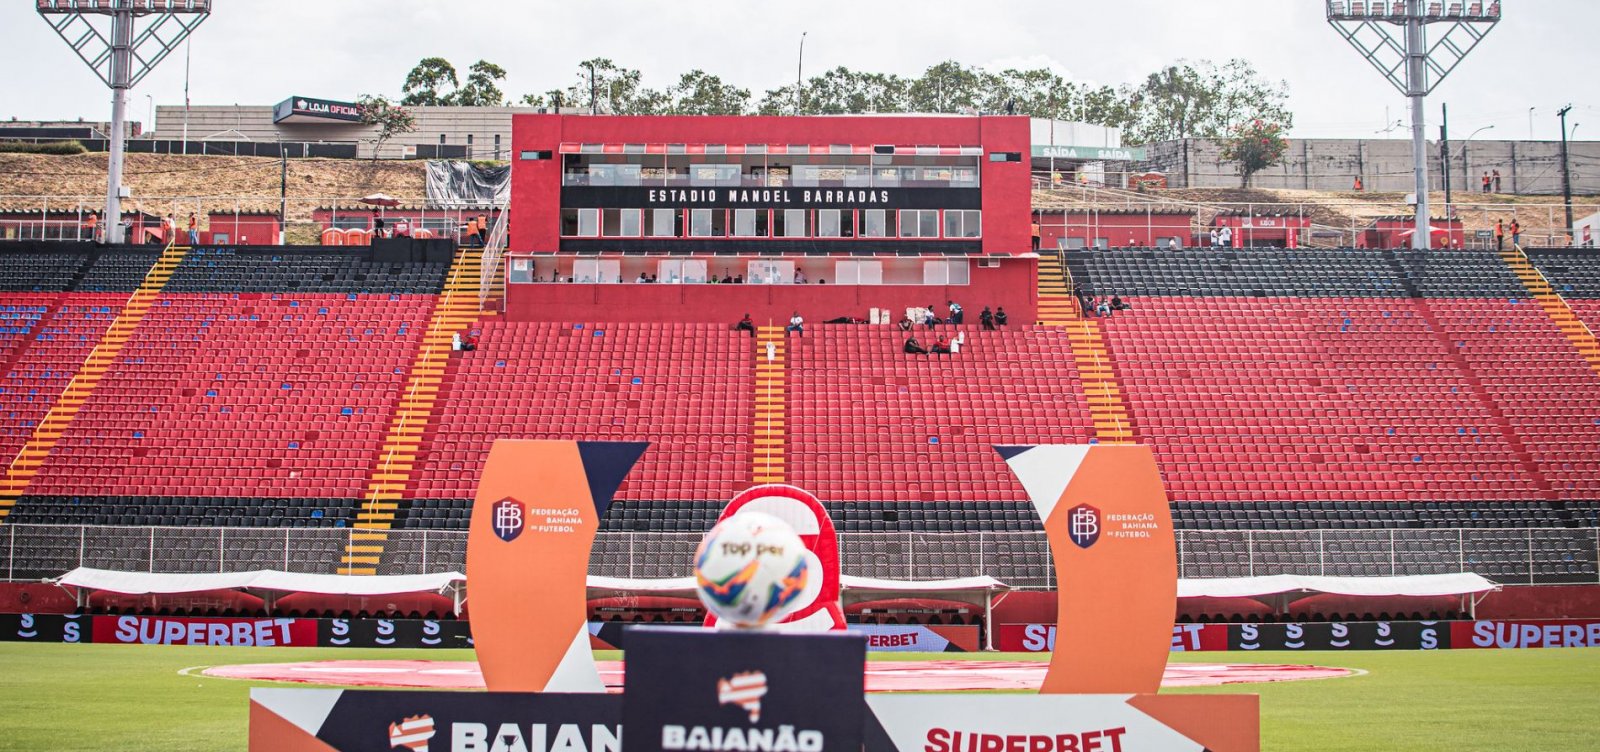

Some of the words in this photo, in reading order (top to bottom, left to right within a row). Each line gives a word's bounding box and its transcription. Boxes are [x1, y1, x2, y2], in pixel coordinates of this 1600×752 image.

[309, 102, 329, 113] LOJA
[330, 105, 359, 116] OFICIAL
[1043, 146, 1077, 158] SAÍDA
[1097, 149, 1131, 160] SAÍDA
[649, 189, 716, 202] ESTADIO
[729, 190, 791, 203] MANOEL
[803, 190, 889, 203] BARRADAS
[531, 508, 579, 517] FEDERAÇÃO
[1107, 513, 1154, 522] FEDERAÇÃO
[539, 525, 574, 533] FUTEBOL
[115, 615, 295, 647] SUPERBET
[866, 632, 919, 647] ERBET
[662, 725, 824, 752] BAIANÃO
[924, 726, 1126, 752] SUPERBET
